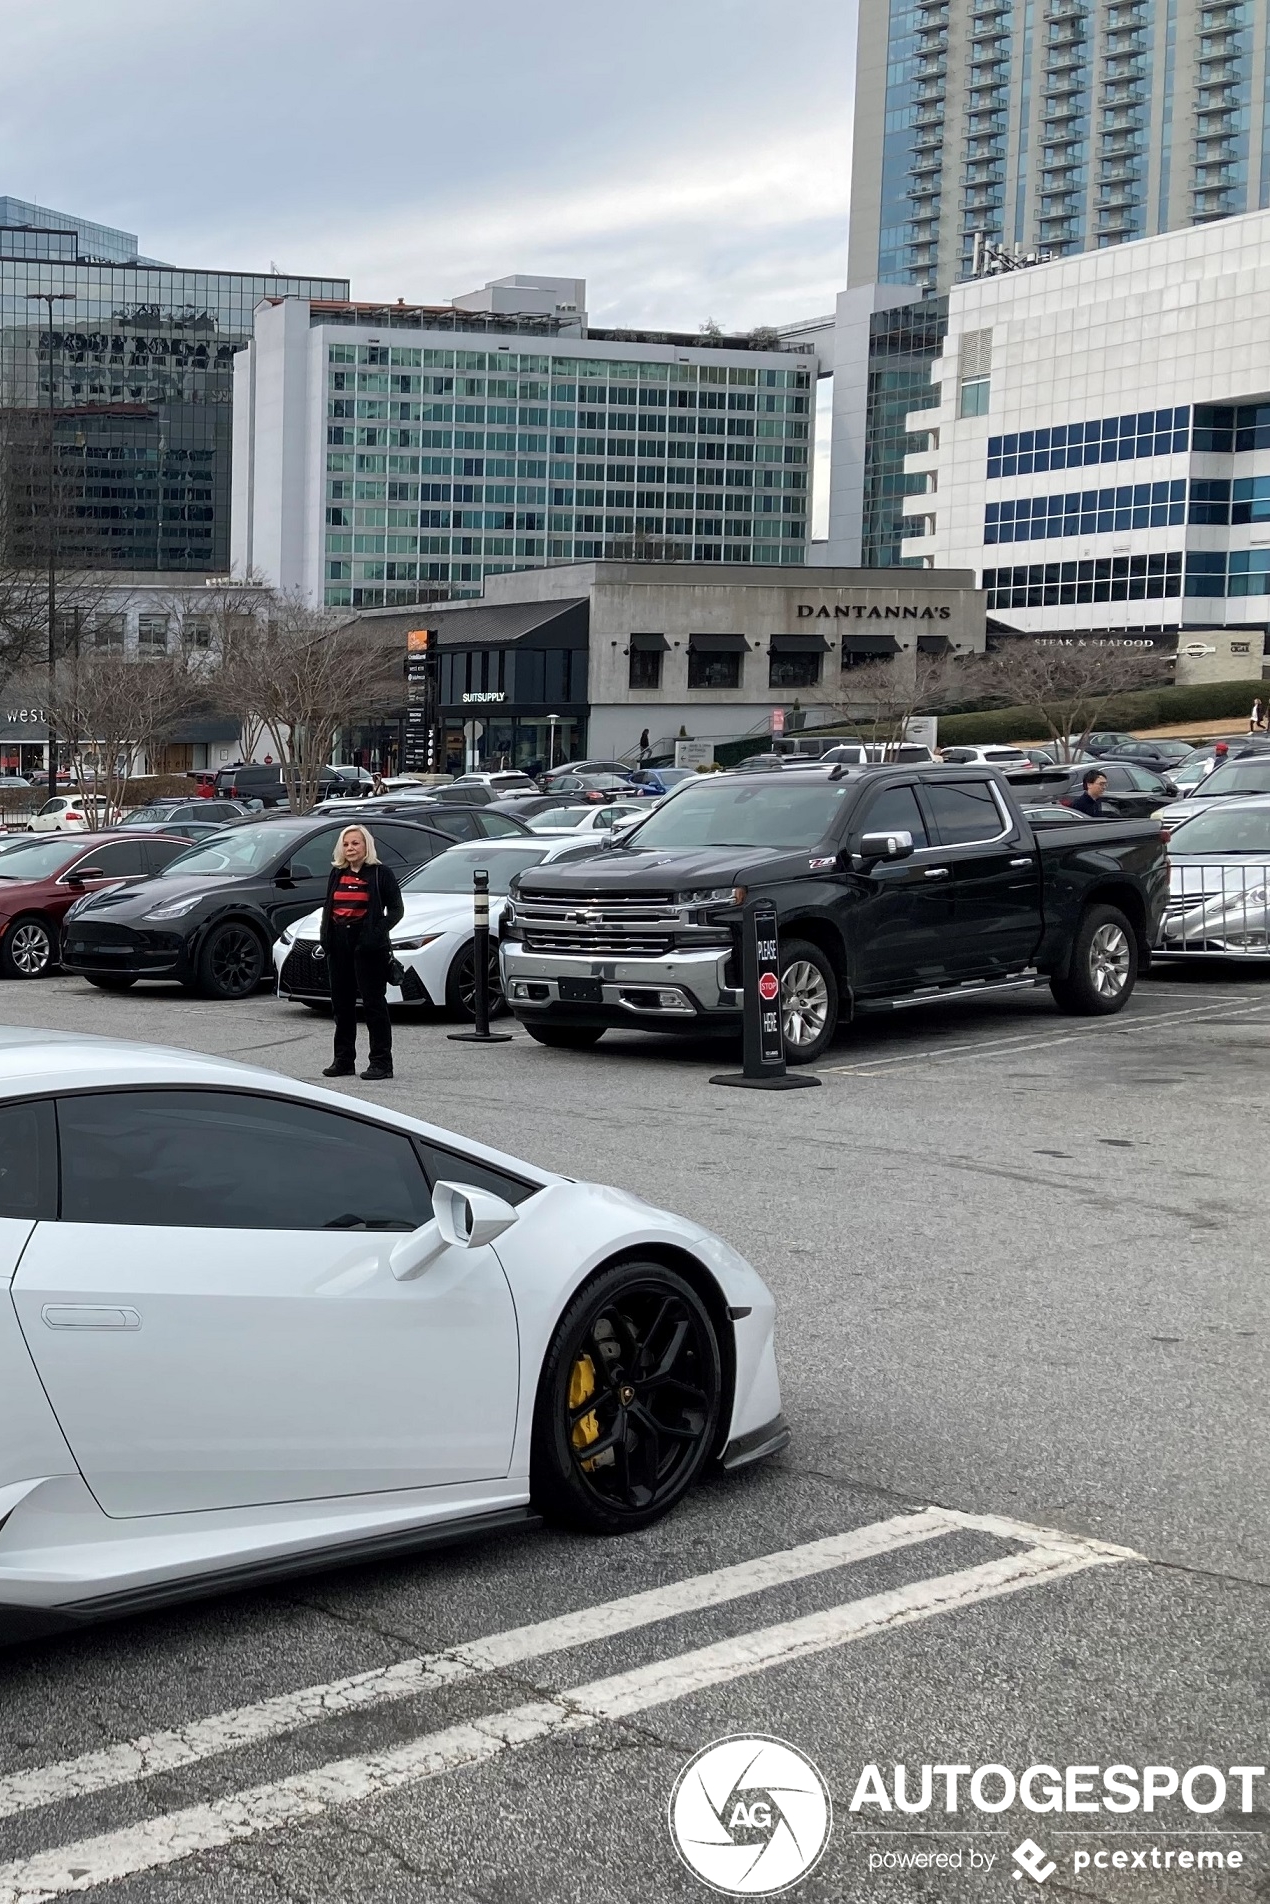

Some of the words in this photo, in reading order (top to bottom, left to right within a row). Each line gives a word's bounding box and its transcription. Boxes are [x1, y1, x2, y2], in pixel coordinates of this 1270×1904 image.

[797, 604, 951, 619] DANTANNA'S
[1034, 639, 1073, 647] STEAK
[1078, 639, 1087, 647] &
[1092, 639, 1154, 647] SEAFOOD
[462, 692, 505, 702] SUITSUPPLY
[757, 940, 777, 960] PLEASE
[761, 982, 777, 991] STOP
[763, 1012, 778, 1032] HERE
